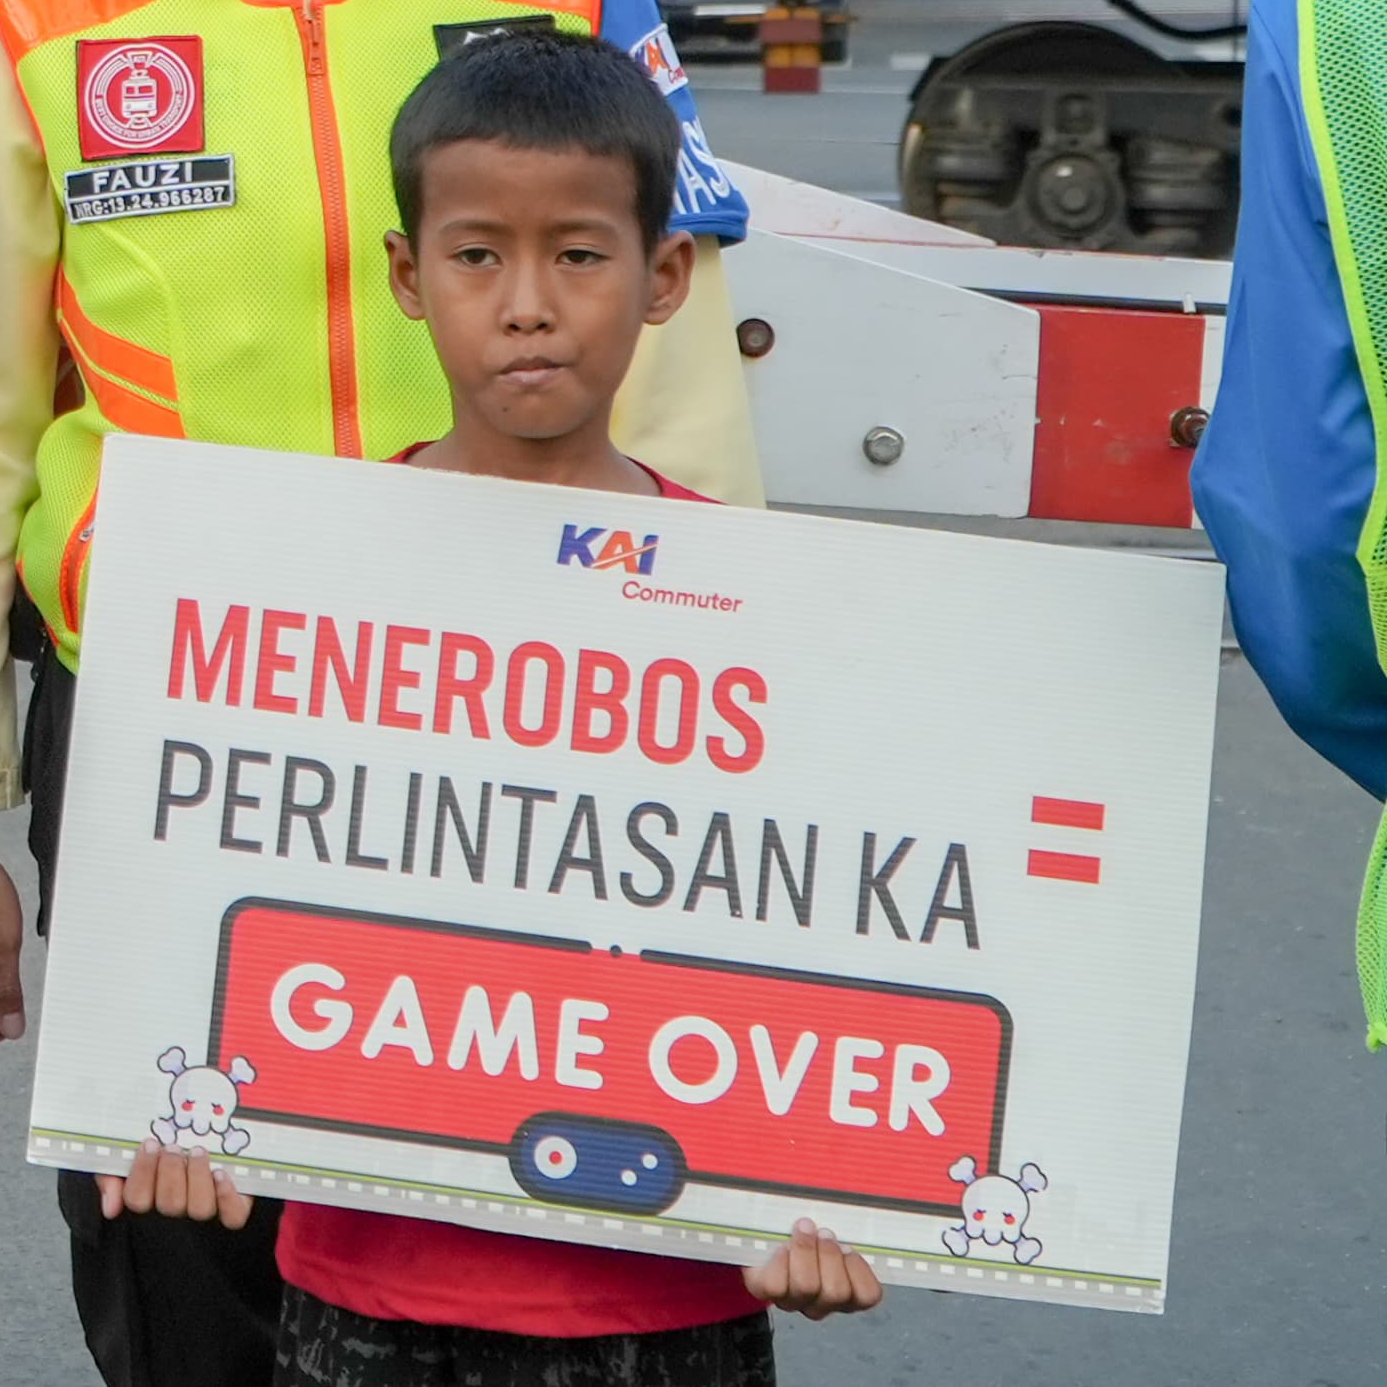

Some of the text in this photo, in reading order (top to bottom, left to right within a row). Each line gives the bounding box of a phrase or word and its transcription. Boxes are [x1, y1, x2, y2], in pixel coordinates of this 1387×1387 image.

[92, 161, 193, 194] FAUZI
[557, 524, 658, 575] KAI
[621, 581, 742, 612] Commuter
[166, 598, 768, 774] MENEROBOS
[154, 739, 818, 928] PERLINTASAN
[855, 831, 980, 950] KA
[270, 962, 952, 1137] GAME OVER
